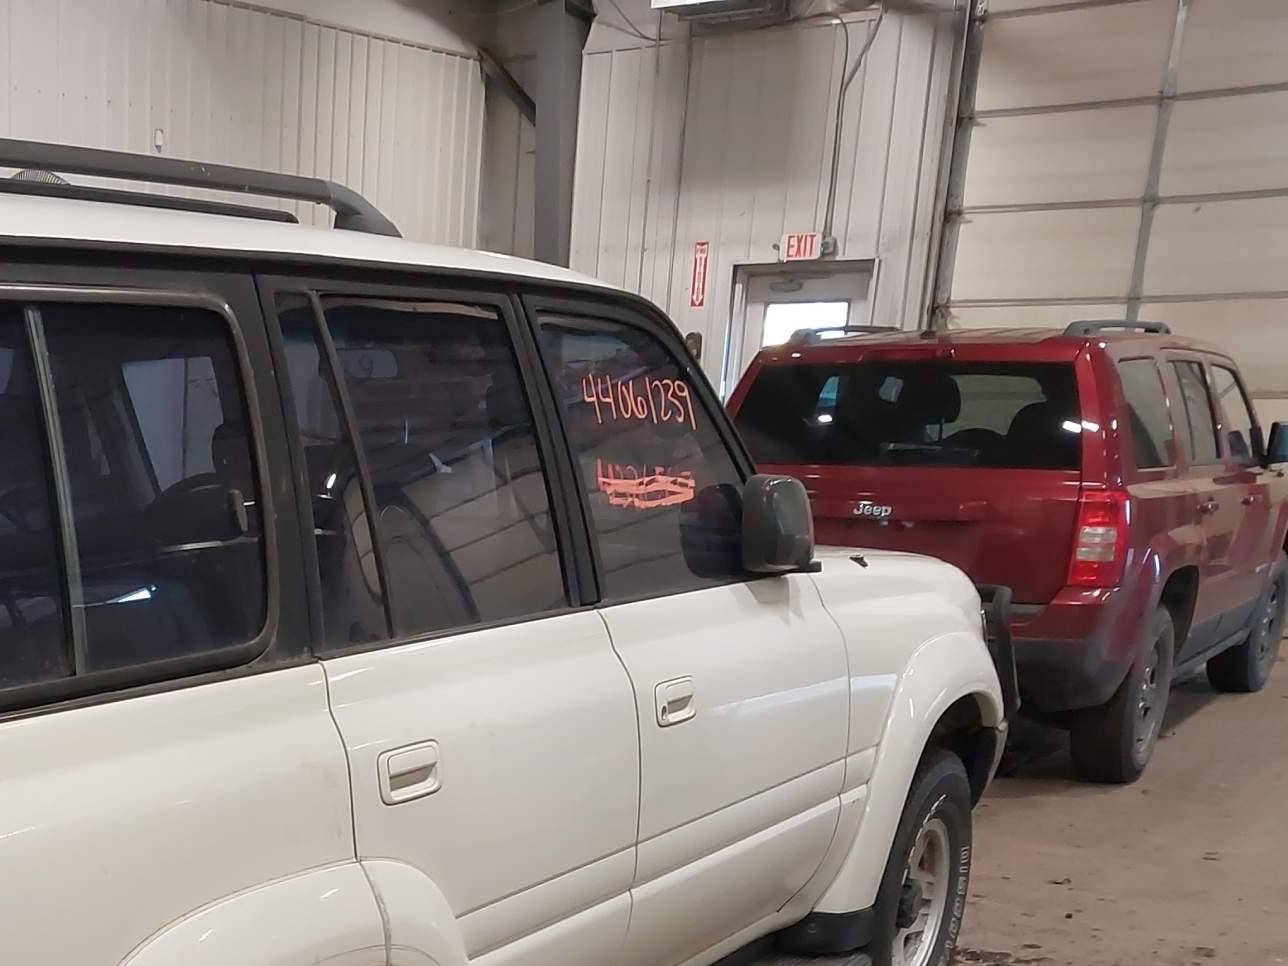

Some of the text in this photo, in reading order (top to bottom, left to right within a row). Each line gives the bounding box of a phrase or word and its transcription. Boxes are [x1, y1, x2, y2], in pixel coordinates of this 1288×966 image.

[787, 234, 817, 258] EXIT
[582, 373, 696, 431] 44061239
[853, 503, 892, 516] Jeep
